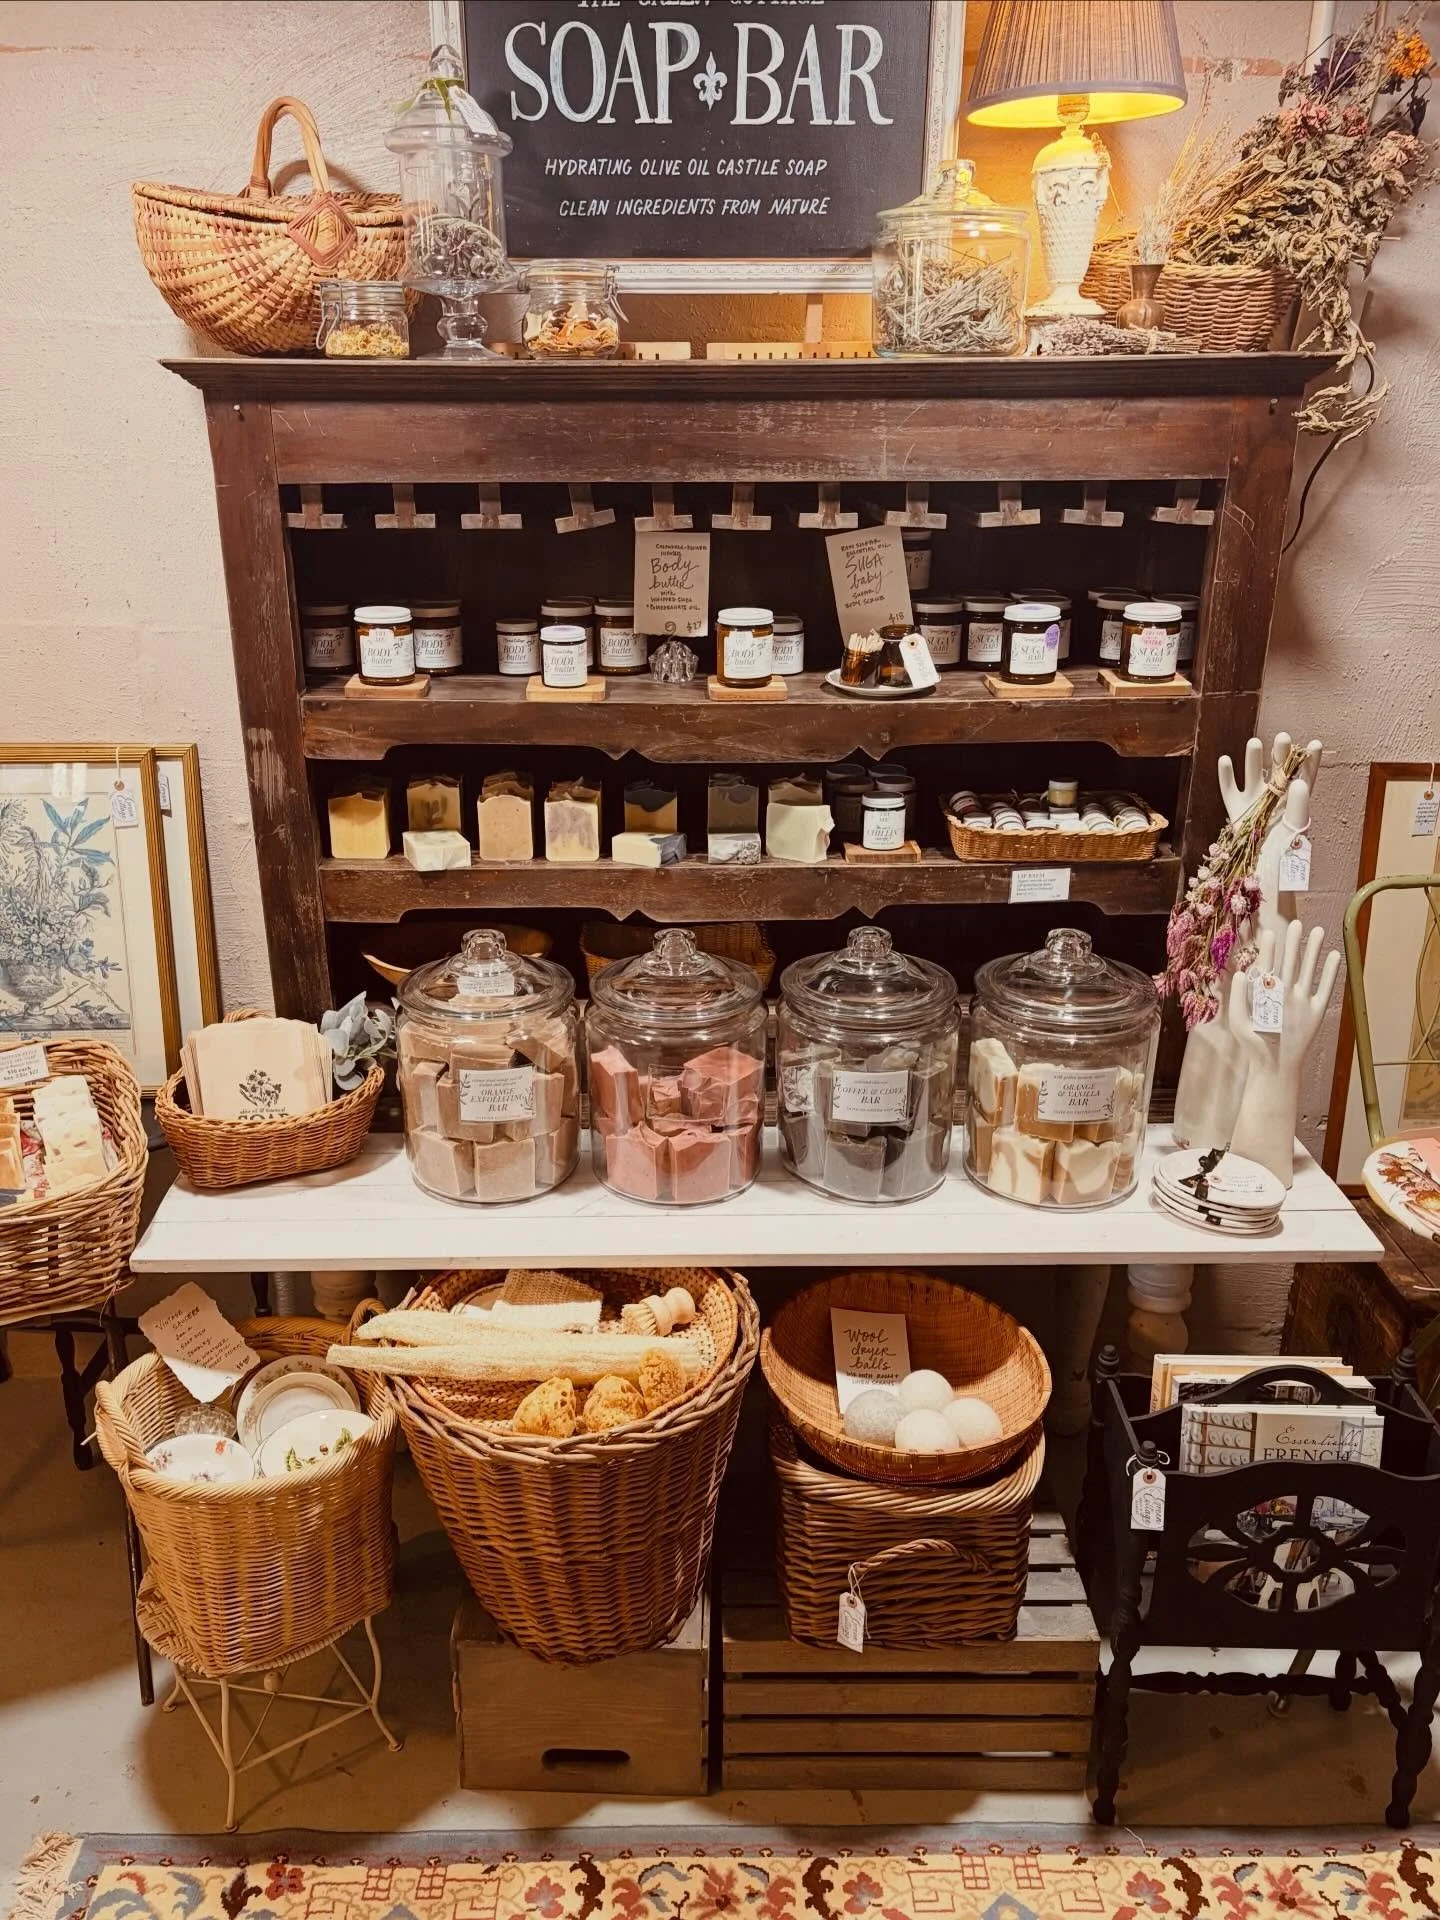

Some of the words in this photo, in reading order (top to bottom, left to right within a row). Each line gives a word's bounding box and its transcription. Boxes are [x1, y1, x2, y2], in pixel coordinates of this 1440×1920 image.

[504, 21, 700, 125] SOAP
[730, 23, 893, 125] BAR
[545, 159, 632, 175] HYDRATING
[640, 159, 682, 175] OLIVE
[688, 159, 709, 175] OIL
[717, 159, 780, 175] CASTILE
[785, 159, 827, 175] SOAP
[559, 199, 608, 217] CLEAN
[616, 199, 715, 215] INGREDIENTS
[722, 199, 760, 215] FROM
[768, 197, 830, 215] NATURE
[650, 555, 700, 581] Body
[845, 552, 884, 578] SUGA
[649, 575, 694, 590] butter
[311, 640, 335, 648] BODY
[420, 640, 444, 648] BODY
[608, 638, 631, 646] BODY
[368, 648, 392, 656] BODY
[504, 646, 526, 654] BODY
[550, 656, 574, 666] BODY
[481, 1088, 516, 1096] ORANGE
[838, 1087, 866, 1095] COFFEE
[1068, 1090, 1100, 1098] VANILLA
[861, 1096, 880, 1104] BAR
[1068, 1098, 1088, 1106] BAR
[489, 1104, 508, 1112] BAR
[844, 1328, 888, 1343] Wool
[852, 1342, 896, 1360] dryer
[849, 1357, 890, 1370] balls
[1264, 1448, 1352, 1461] FRENCH
